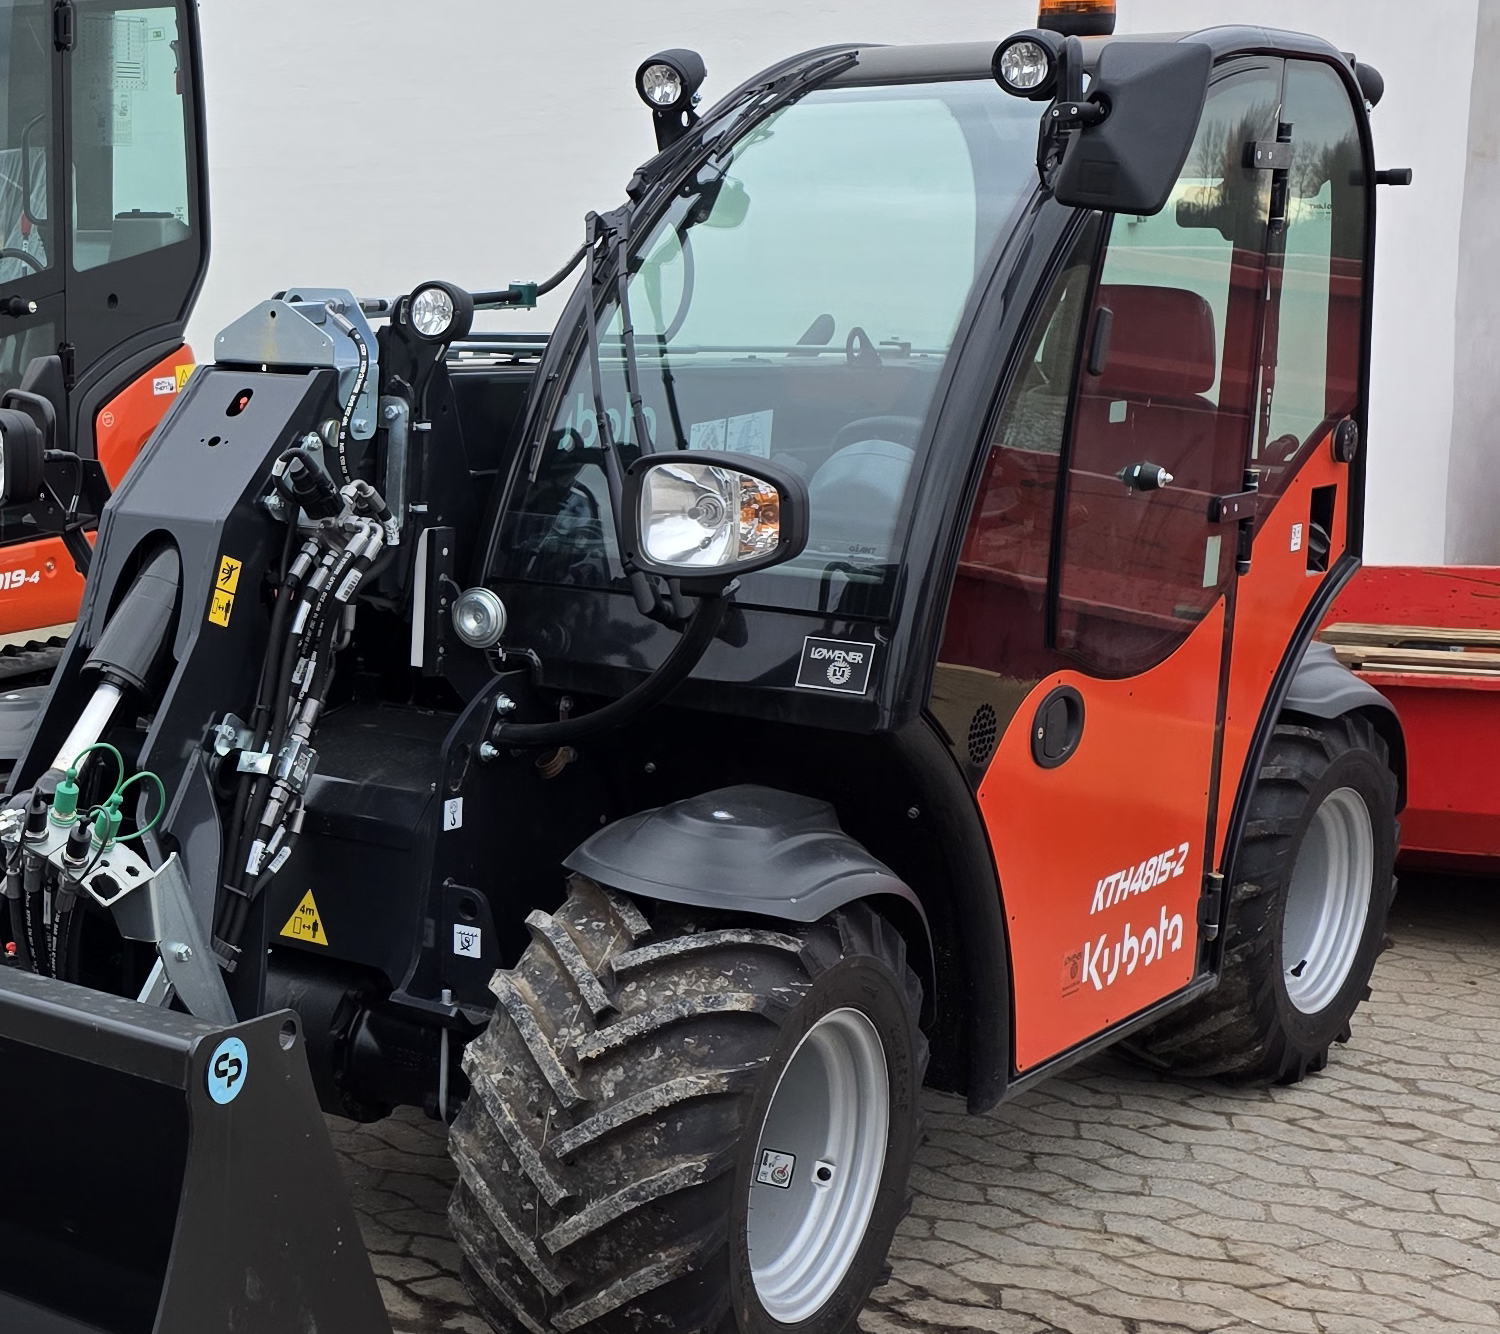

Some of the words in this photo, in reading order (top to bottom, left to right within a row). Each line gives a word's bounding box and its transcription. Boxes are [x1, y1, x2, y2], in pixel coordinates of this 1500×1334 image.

[810, 647, 864, 664] LØWENER
[1090, 841, 1190, 915] KTH4815-2
[299, 904, 315, 917] 4m
[1081, 905, 1184, 991] Kubota
